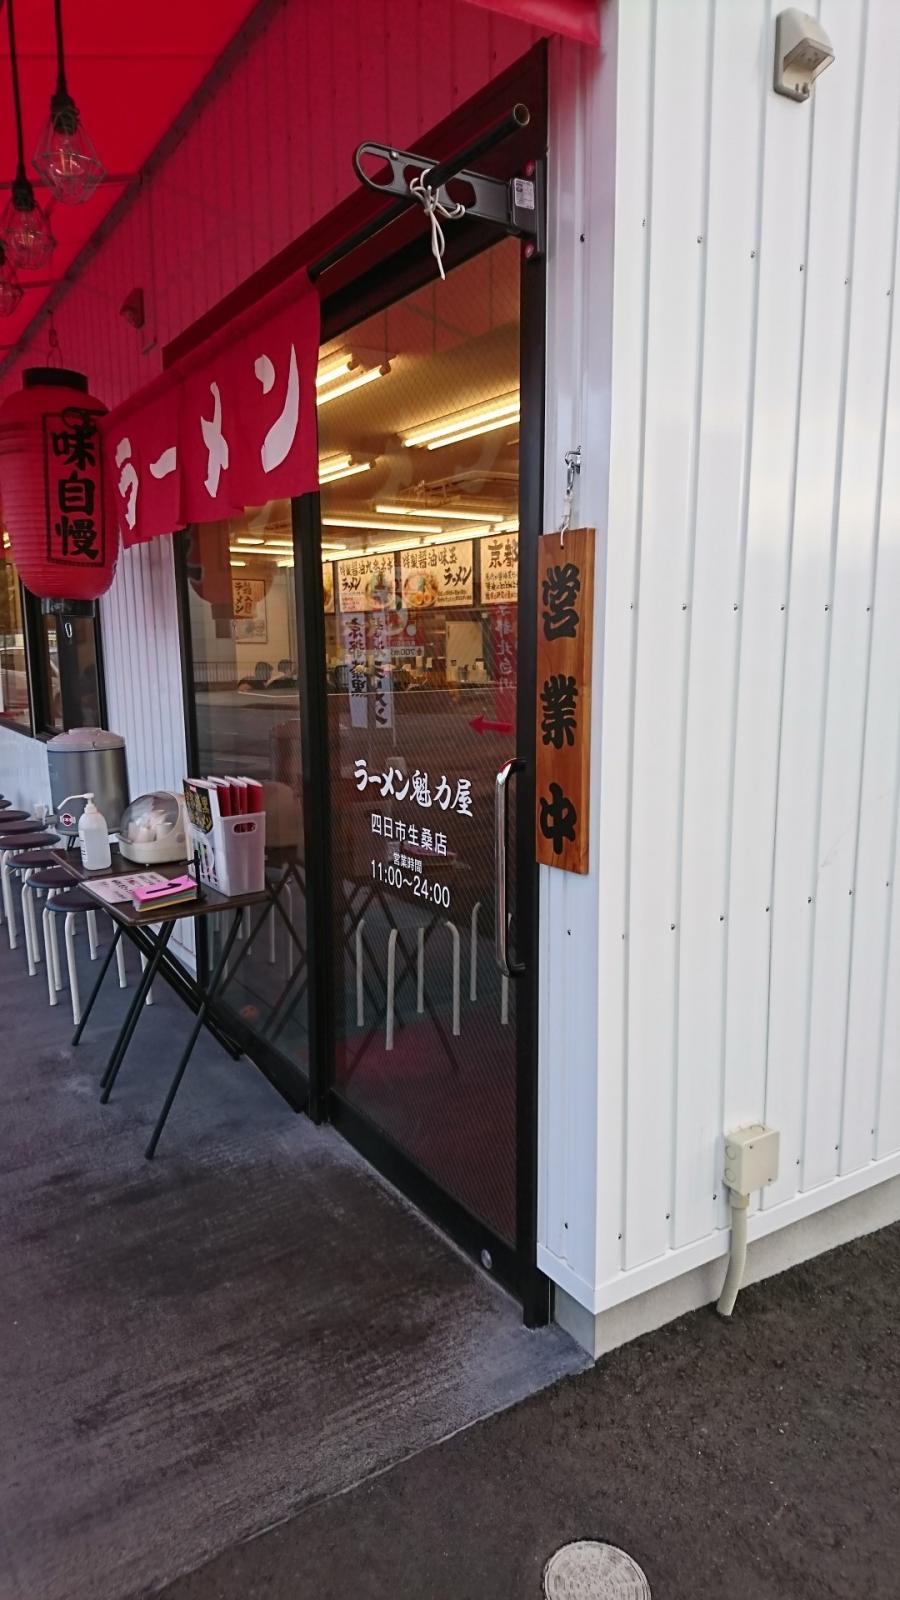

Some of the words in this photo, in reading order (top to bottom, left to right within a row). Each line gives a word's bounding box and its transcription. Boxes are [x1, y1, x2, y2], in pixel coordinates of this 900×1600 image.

[115, 344, 299, 530] ラーメン
[53, 412, 103, 559] 味自慢
[342, 577, 361, 592] ラーメン
[444, 566, 472, 586] ラーメン
[539, 563, 580, 855] 営業中
[354, 759, 473, 818] ラーメン魁力屋
[371, 813, 448, 857] 四日市生桑店
[393, 853, 423, 874] 営業時間
